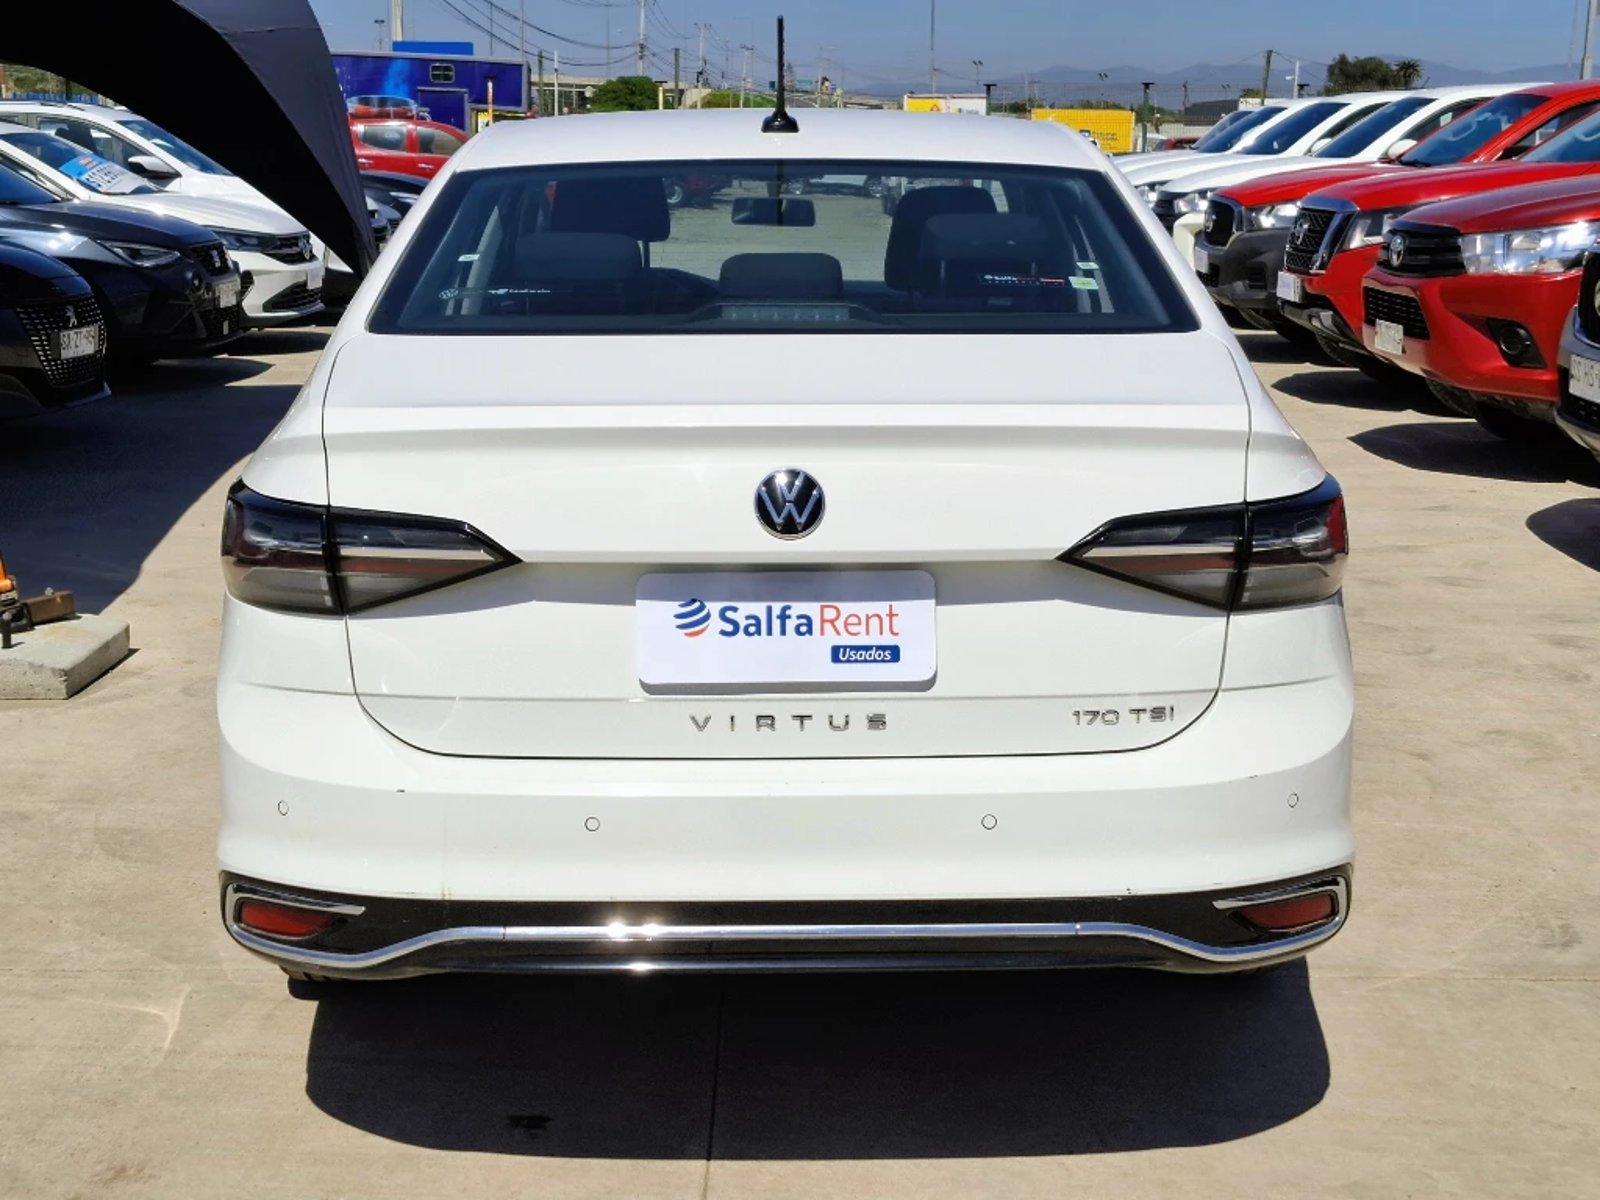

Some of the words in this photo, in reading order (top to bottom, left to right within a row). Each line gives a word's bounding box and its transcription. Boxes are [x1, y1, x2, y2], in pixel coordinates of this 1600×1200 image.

[718, 604, 900, 637] SalfaRent
[838, 647, 892, 661] Usados
[689, 713, 888, 732] VIRTUS
[1072, 709, 1120, 726] 170
[1128, 706, 1175, 724] TSI
